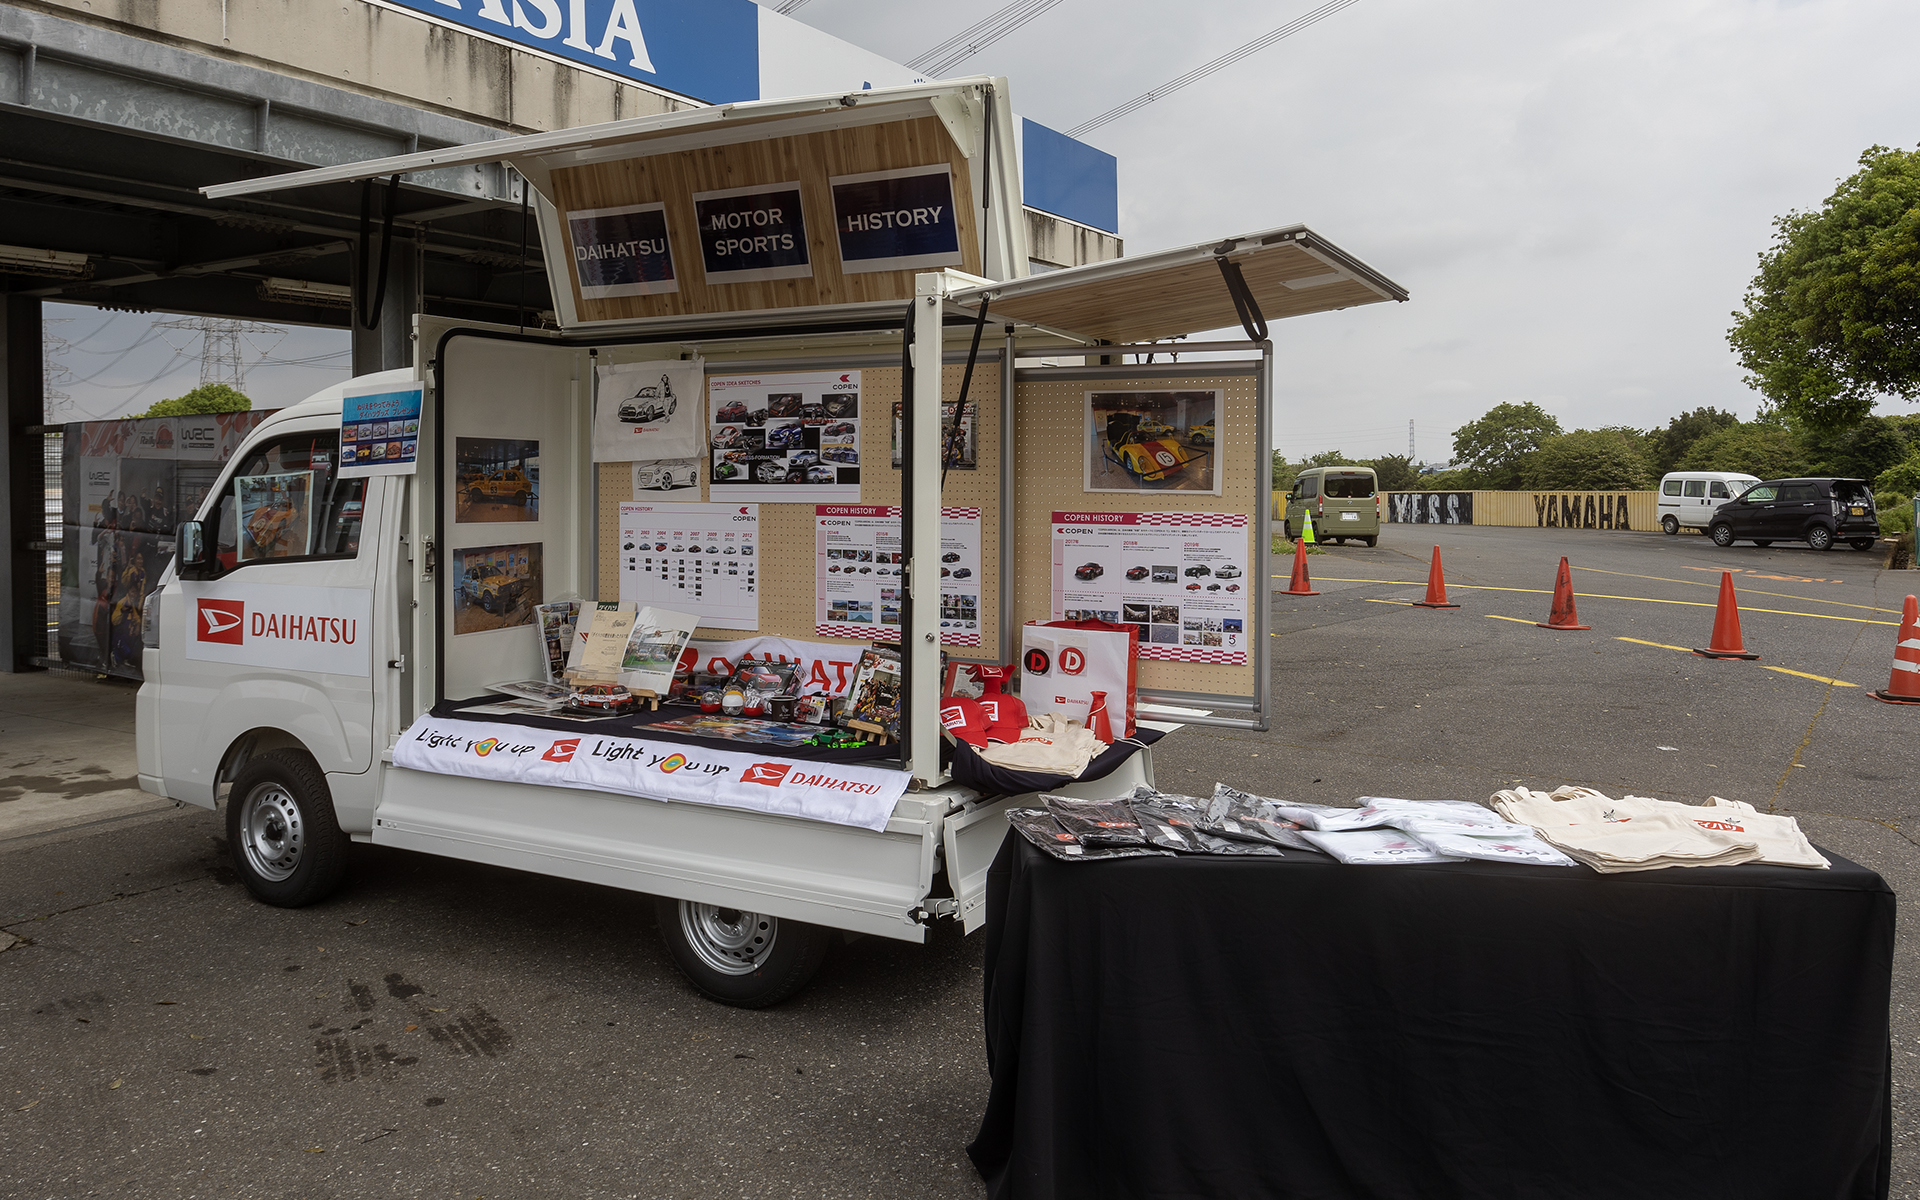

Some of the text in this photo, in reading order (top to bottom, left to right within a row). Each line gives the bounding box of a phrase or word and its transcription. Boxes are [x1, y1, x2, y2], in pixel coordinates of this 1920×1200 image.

[434, 0, 656, 74] IA
[711, 207, 783, 231] MOTOR
[847, 206, 943, 232] HISTORY
[576, 238, 666, 261] DAIHATSU
[715, 233, 794, 256] SPORTS
[181, 428, 214, 441] WRC
[1158, 453, 1172, 463] 15
[849, 507, 877, 515] HISTORY
[1092, 514, 1124, 522] HISTORY
[1533, 494, 1630, 530] YAMAHA
[252, 612, 357, 645] DAIHATSU
[415, 728, 463, 748] Light
[510, 744, 536, 757] up
[592, 740, 645, 762] Light
[789, 772, 881, 796] DAIHATSU
